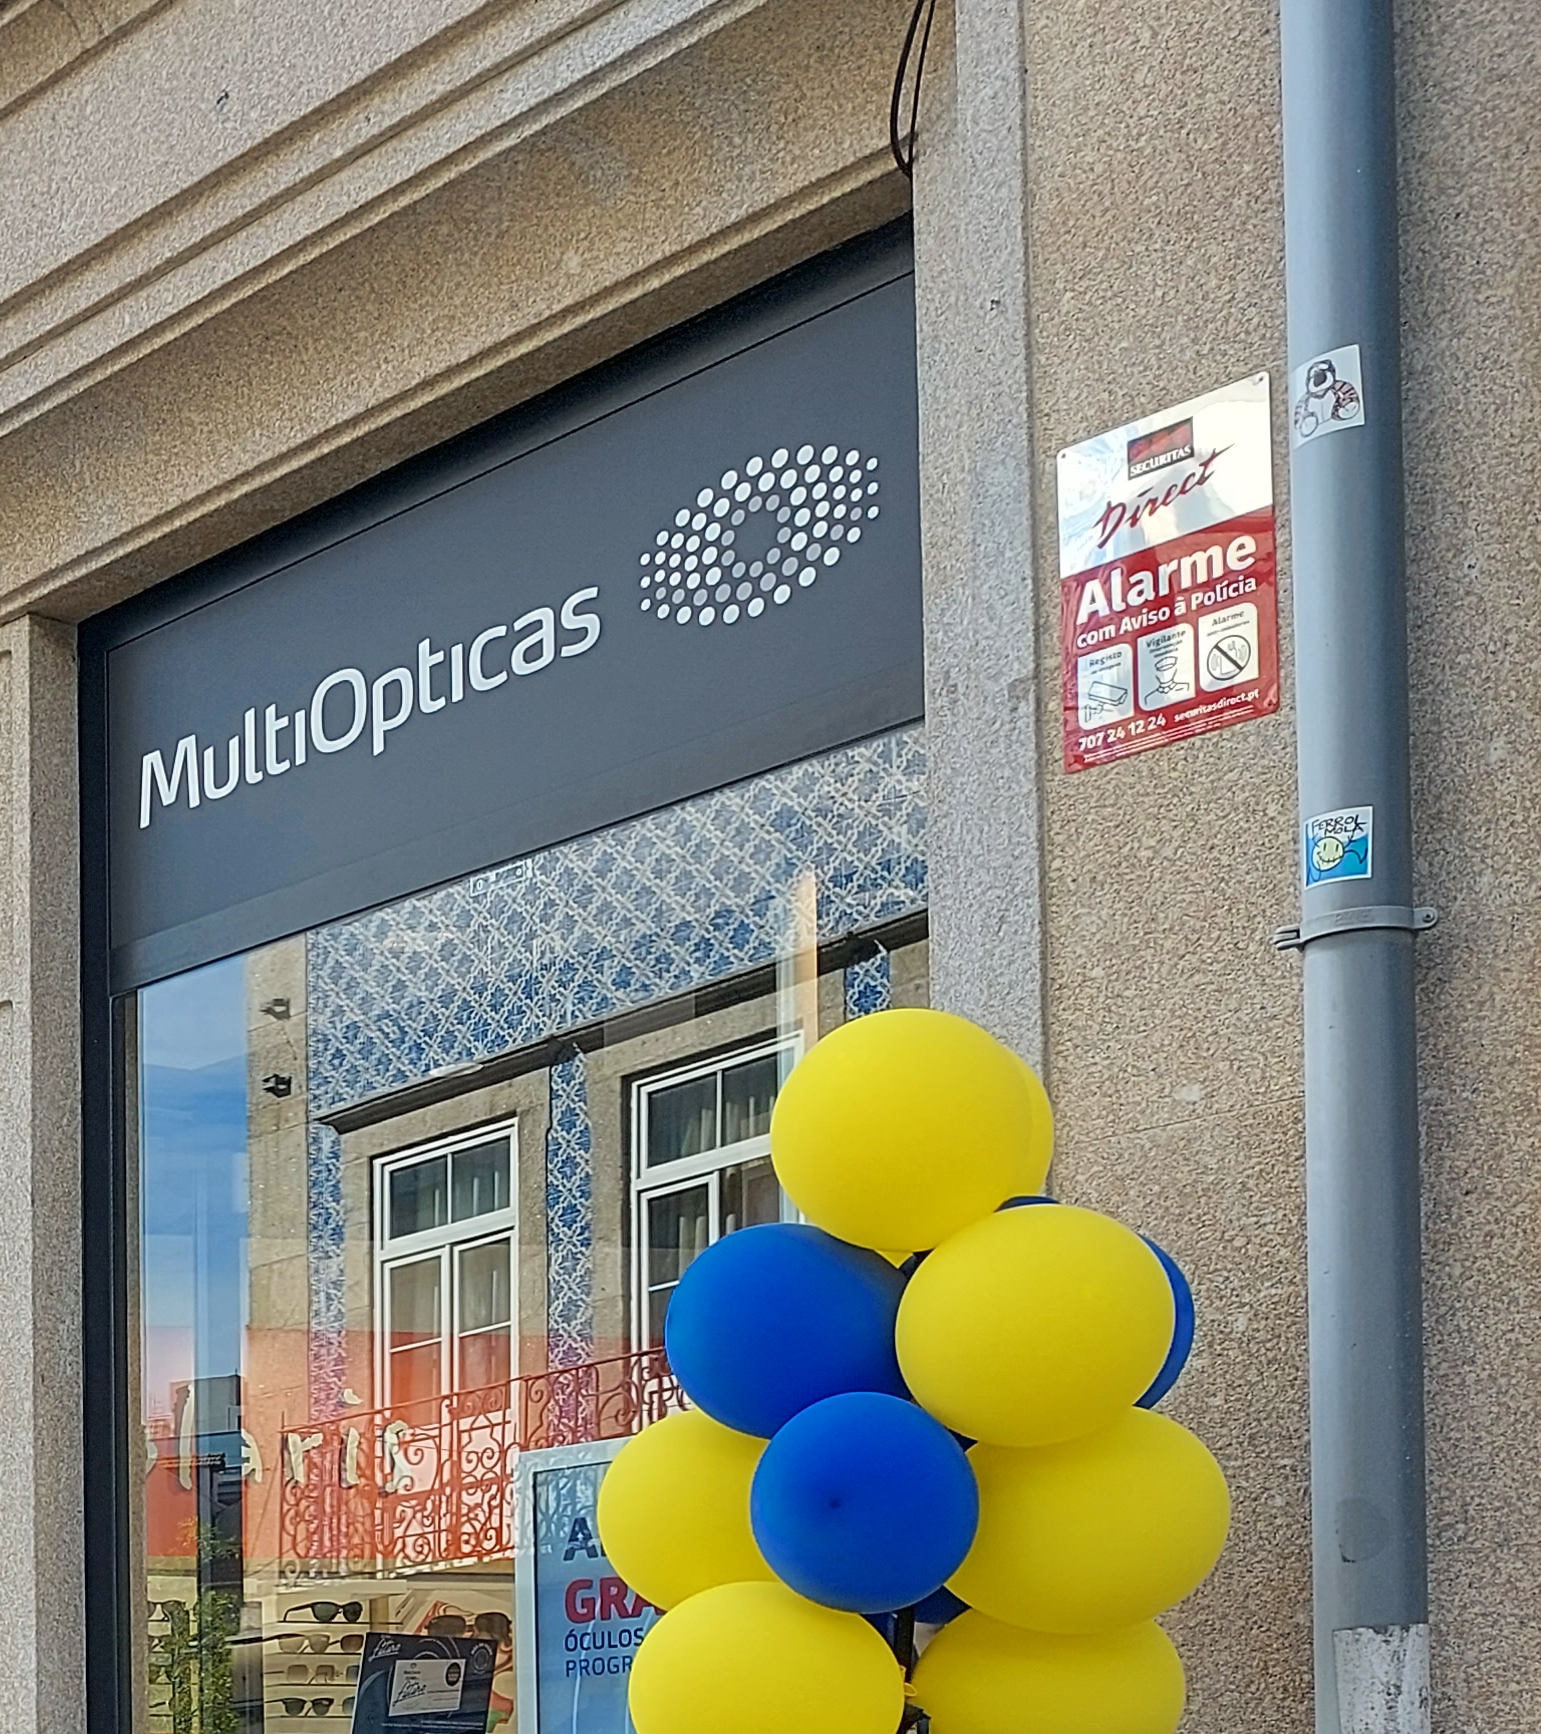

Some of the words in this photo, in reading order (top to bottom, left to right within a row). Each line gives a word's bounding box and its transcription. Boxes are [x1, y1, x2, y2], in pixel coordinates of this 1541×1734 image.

[1130, 445, 1192, 477] SECURITAS
[1093, 443, 1235, 549] Direct
[1076, 535, 1257, 625] Alarme
[1077, 627, 1116, 649] com
[1119, 608, 1171, 635] Aviso
[1174, 597, 1187, 617] à
[1191, 575, 1257, 610] Polícia
[1211, 610, 1245, 627] Alarme
[139, 586, 602, 829] MultiOpticas
[1078, 734, 1104, 751] 707
[1106, 728, 1126, 743] 24
[1128, 721, 1145, 737] 12
[1147, 713, 1166, 731] 24
[1174, 688, 1260, 722] securitasdirect.pt
[564, 1627, 645, 1653] ÓCULOS
[565, 1655, 633, 1678] PROGR
